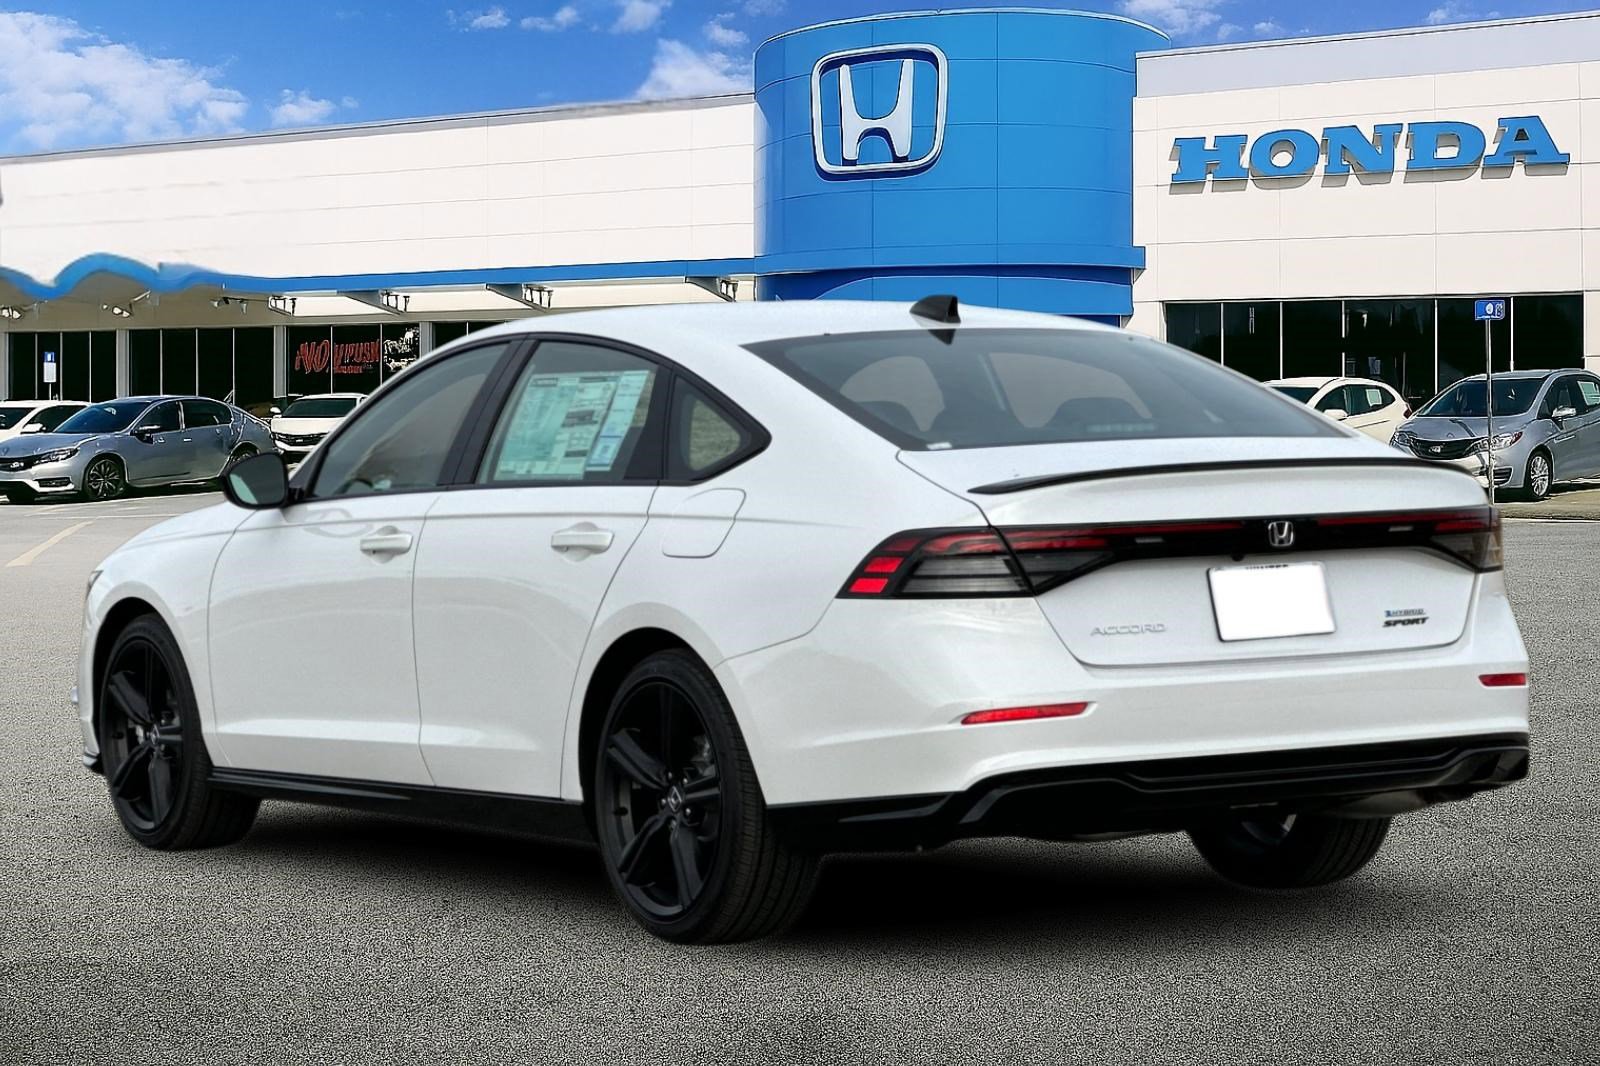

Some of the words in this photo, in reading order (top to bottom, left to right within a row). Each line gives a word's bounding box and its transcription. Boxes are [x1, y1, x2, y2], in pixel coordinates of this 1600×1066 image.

[1170, 114, 1571, 184] HONDA
[1382, 616, 1429, 628] SPORT
[1090, 623, 1167, 637] ACCORD
